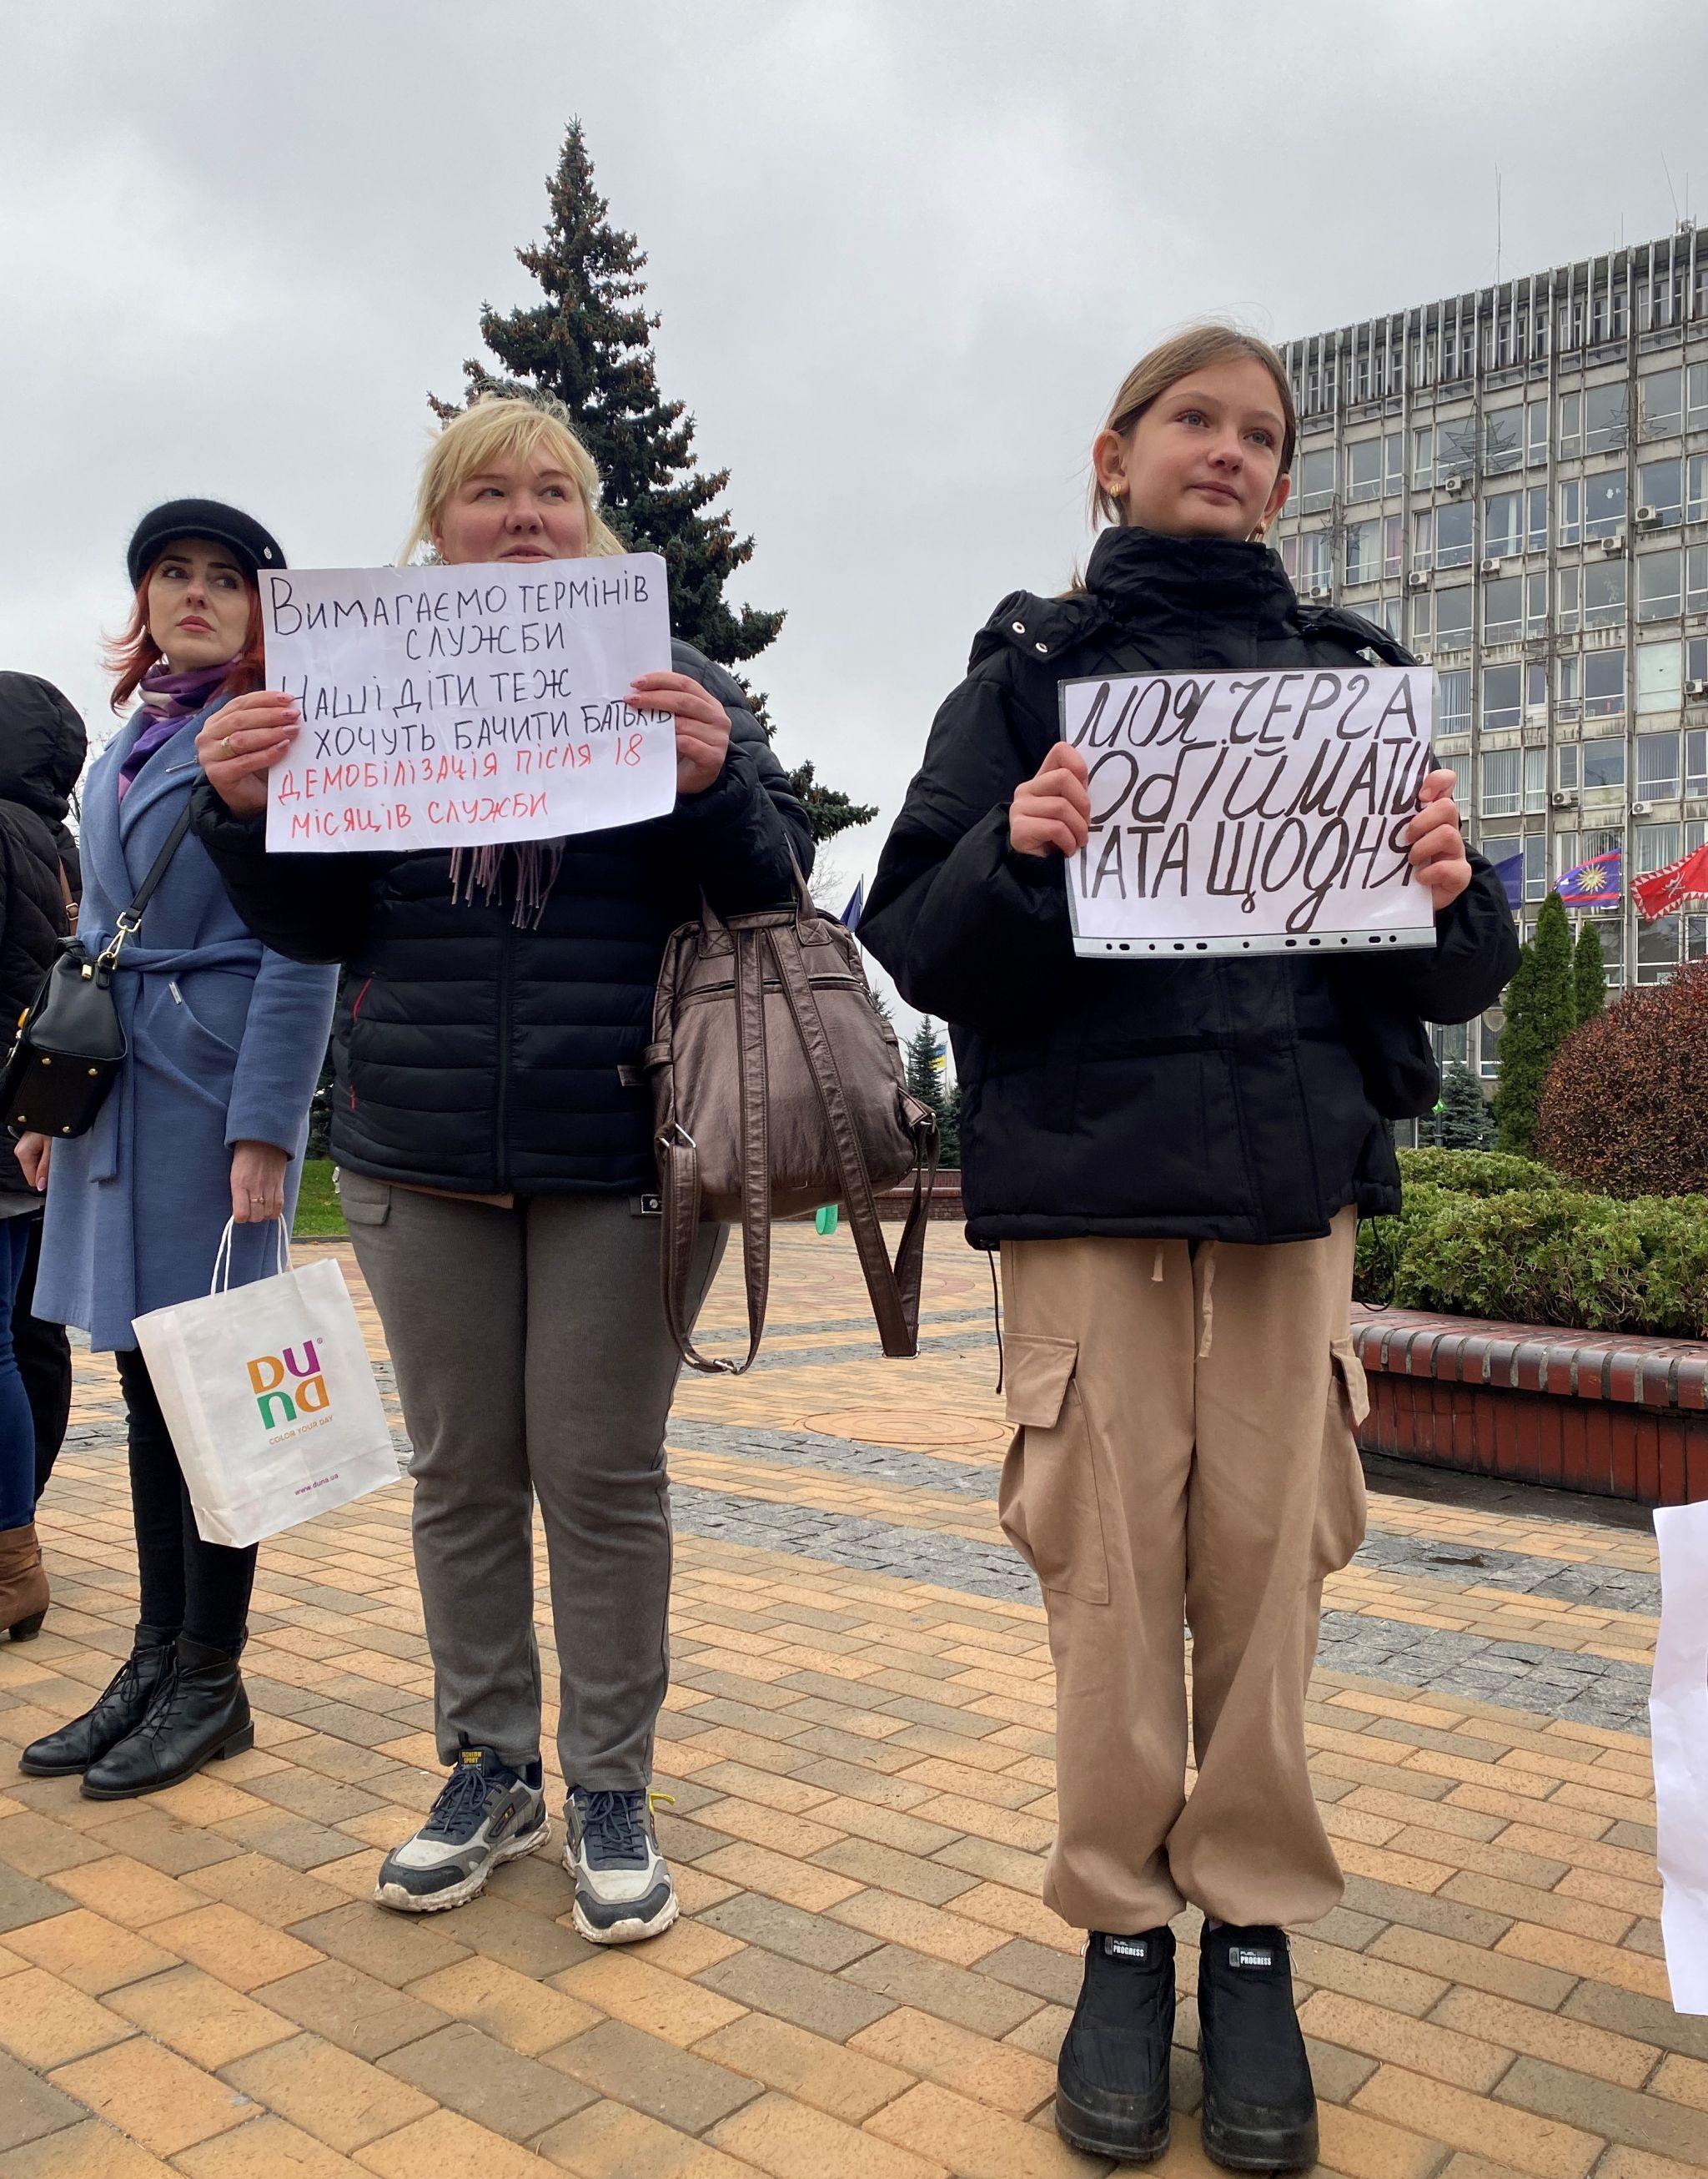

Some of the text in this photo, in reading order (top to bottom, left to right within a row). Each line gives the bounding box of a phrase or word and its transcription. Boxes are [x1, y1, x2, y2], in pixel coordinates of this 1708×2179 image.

[271, 569, 650, 636] ВИМАГАЄМО ТЕРМІНІВ
[405, 621, 565, 661] СЛУЖБИ
[393, 671, 480, 717] ДІТИ
[489, 668, 573, 704] ТЕЖ
[1071, 678, 1215, 748] МОЯ
[314, 725, 436, 760] ХОЧУТЬ
[454, 711, 570, 752] БАЧИТИ
[277, 733, 645, 805] ДЕМОБІЛІЗАЦІЯ ПІСЛЯ 18
[291, 792, 550, 839] МІСЯЦІВ СЛУЖБИ
[269, 1414, 334, 1445] COLOR YOUR DAY
[294, 1472, 339, 1496] www.duna.ua
[1113, 1945, 1144, 1957] PROGRESS
[1240, 1955, 1272, 1966] PROGRESS
